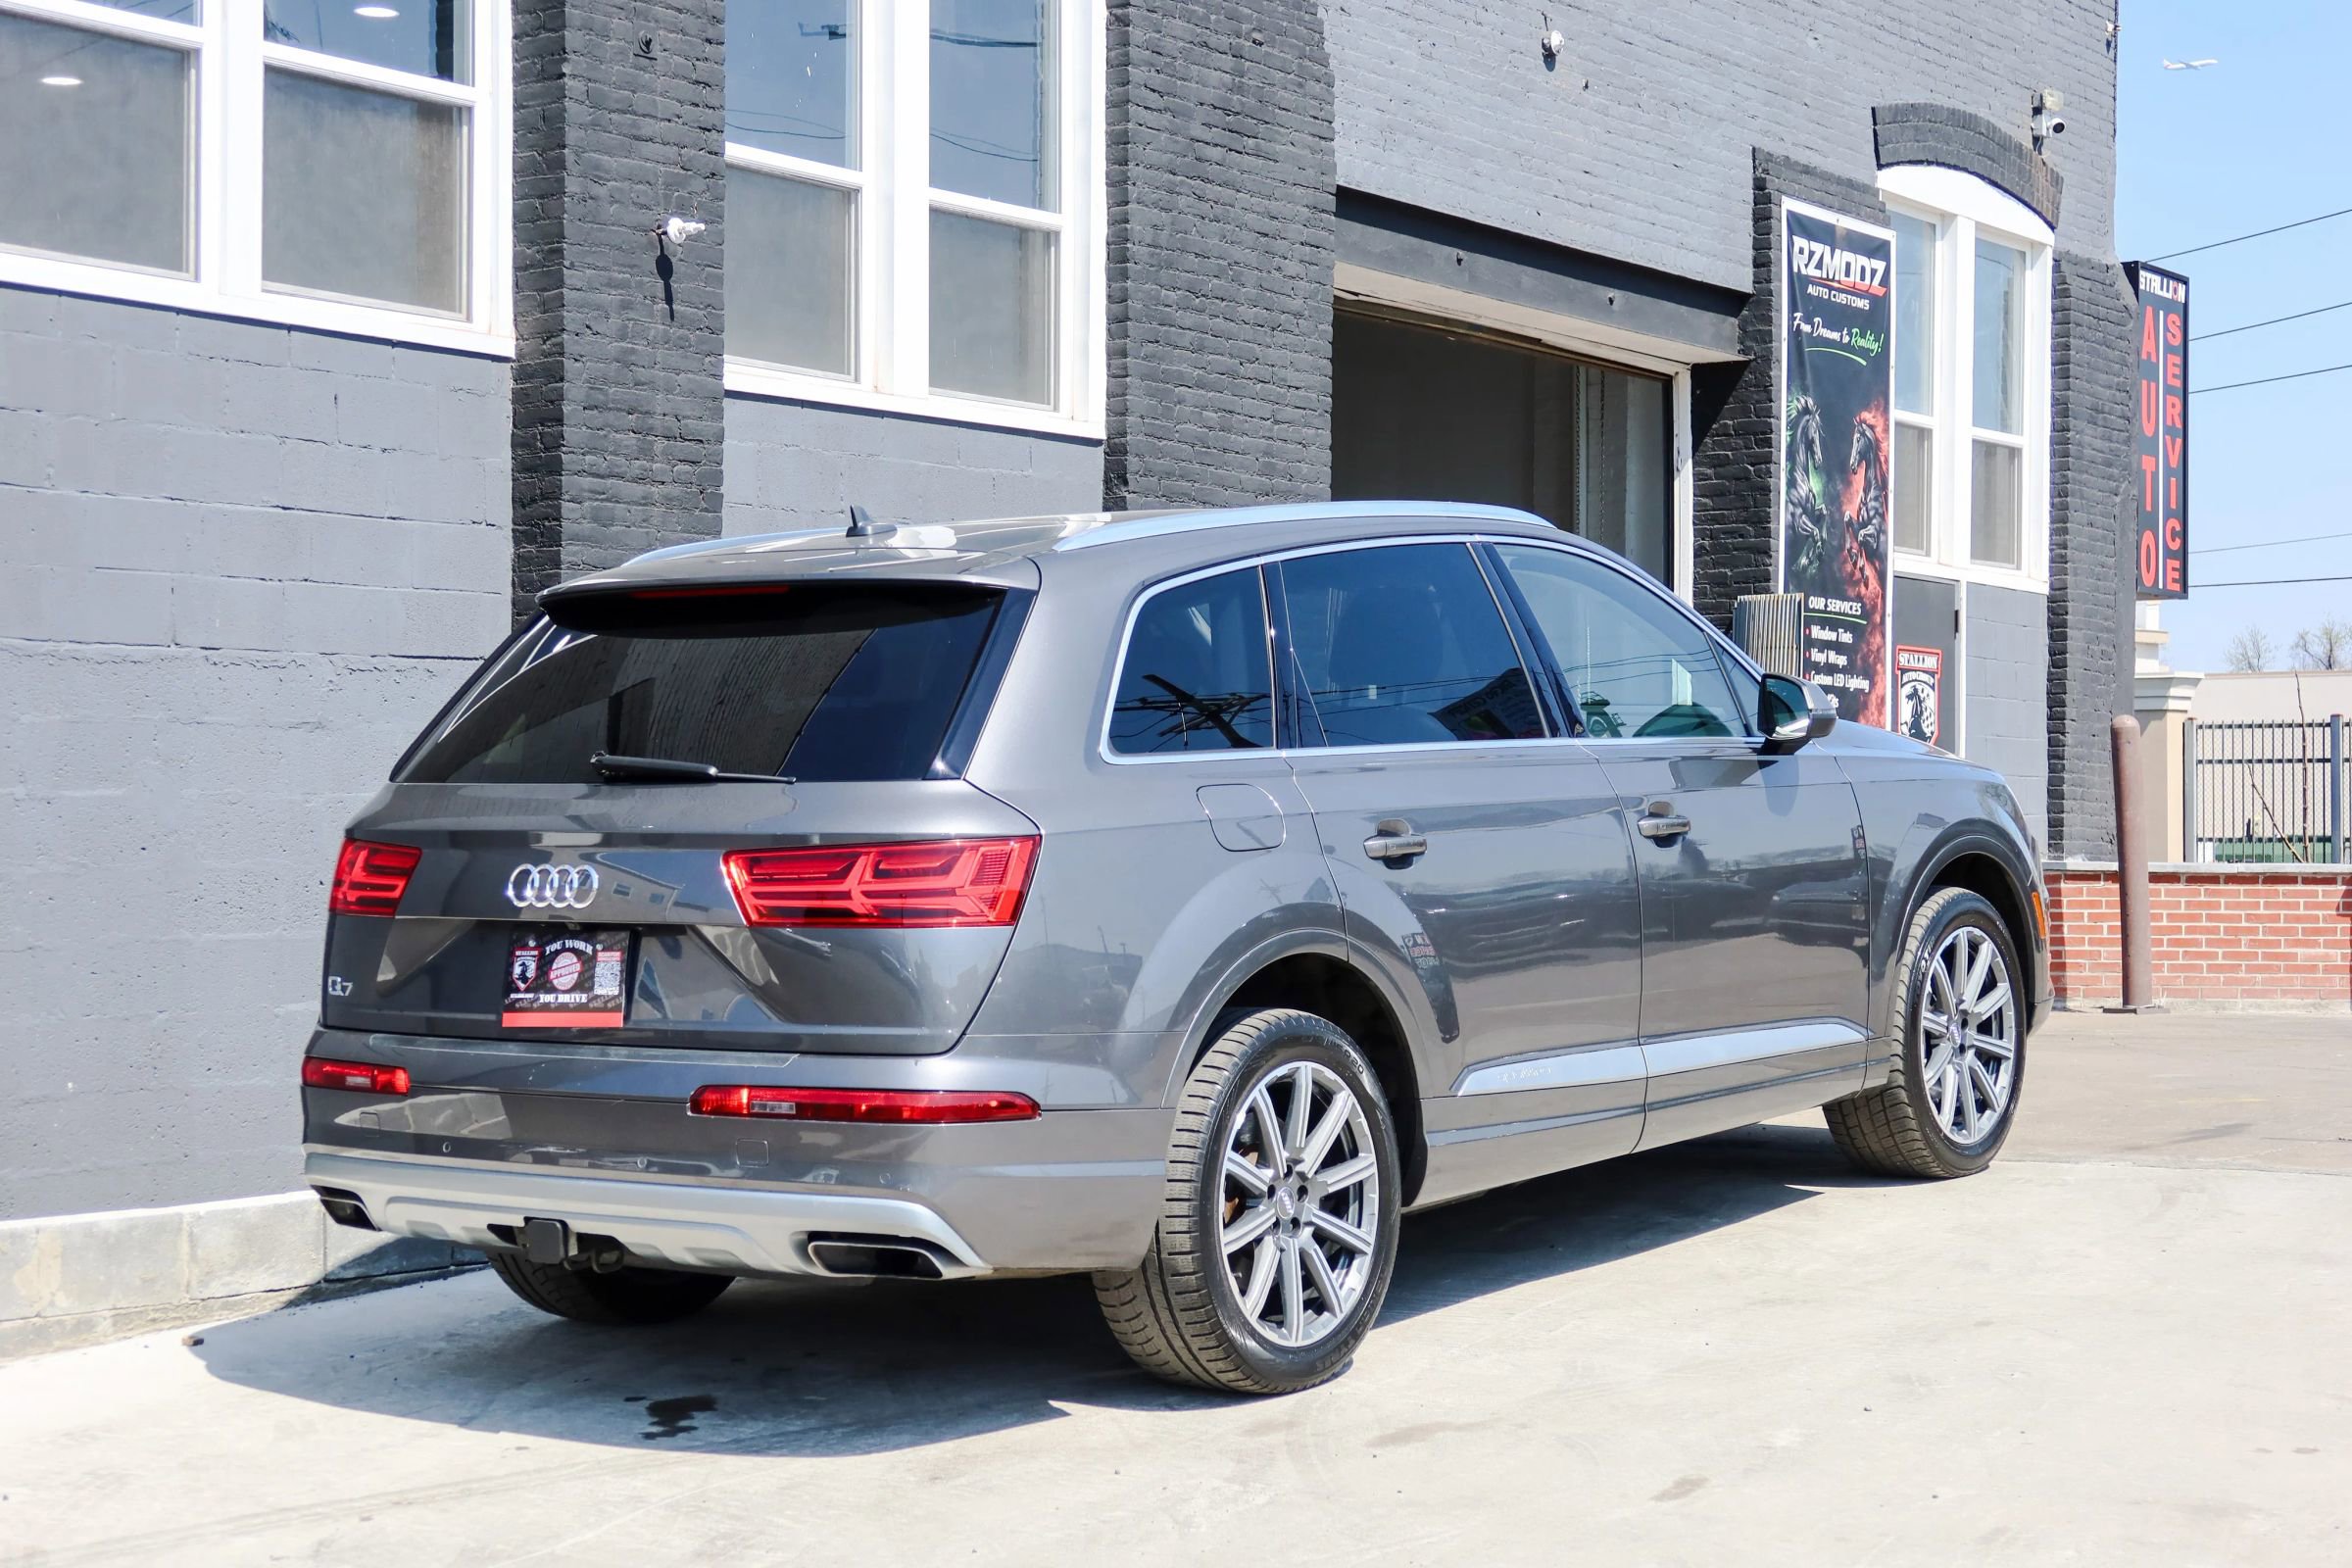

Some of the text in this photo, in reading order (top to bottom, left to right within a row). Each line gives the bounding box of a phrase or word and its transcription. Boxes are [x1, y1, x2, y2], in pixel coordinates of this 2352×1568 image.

[1792, 235, 1887, 296] RZMODZ
[1807, 283, 1870, 311] AUTO CUSTOMS
[2139, 269, 2186, 304] STALLION
[1792, 312, 1885, 357] From Dreams to Reality!
[2141, 305, 2157, 588] AUTO
[2165, 313, 2182, 592] SERVICE
[1808, 596, 1862, 615] OUR SERVICES
[1811, 624, 1853, 644] Window Tints
[1811, 647, 1848, 668] Vinyl Wraps
[1898, 653, 1939, 669] STALLION
[1810, 670, 1870, 693] Custom LED Lighting
[545, 939, 594, 956] YOU WORK
[550, 962, 581, 980] APPROVED
[328, 975, 354, 997] Q7
[539, 994, 557, 1004] YOU
[558, 994, 588, 1004] DRIVE
